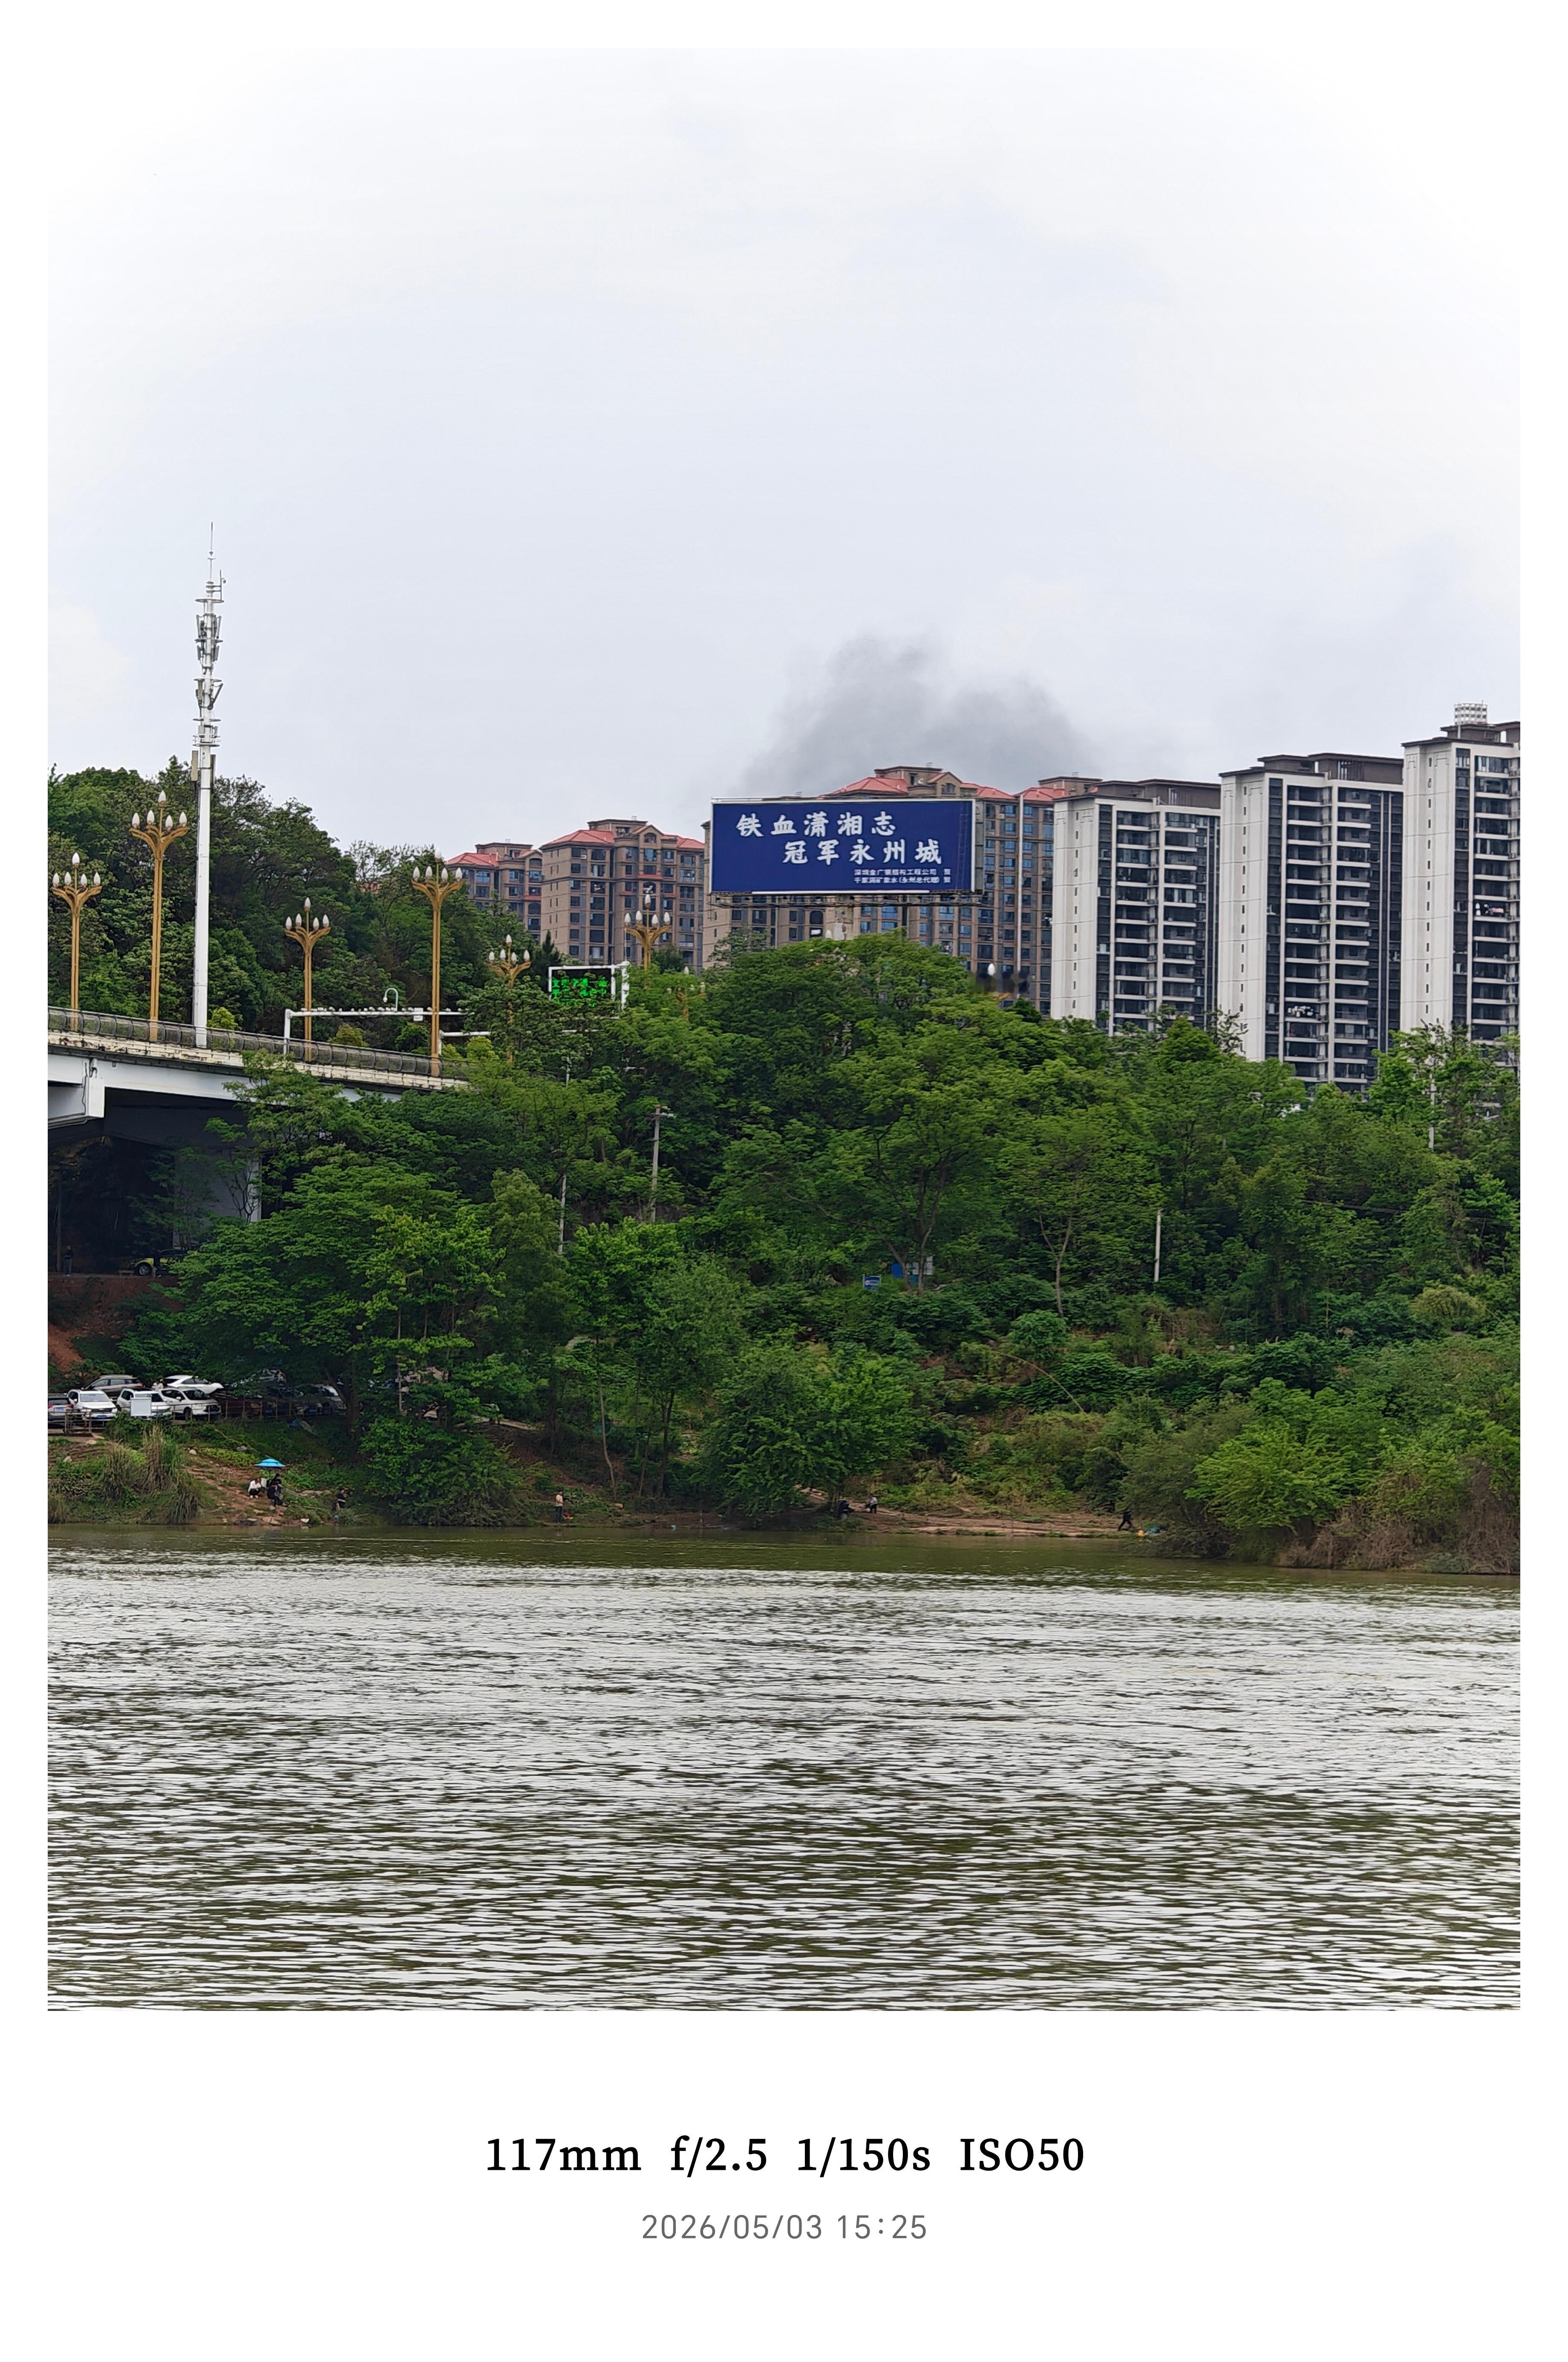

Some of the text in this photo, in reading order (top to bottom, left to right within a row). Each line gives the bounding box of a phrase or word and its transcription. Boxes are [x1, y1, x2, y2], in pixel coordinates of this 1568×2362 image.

[736, 811, 896, 837] 铁血潇湘志
[782, 839, 942, 864] 冠军永州城
